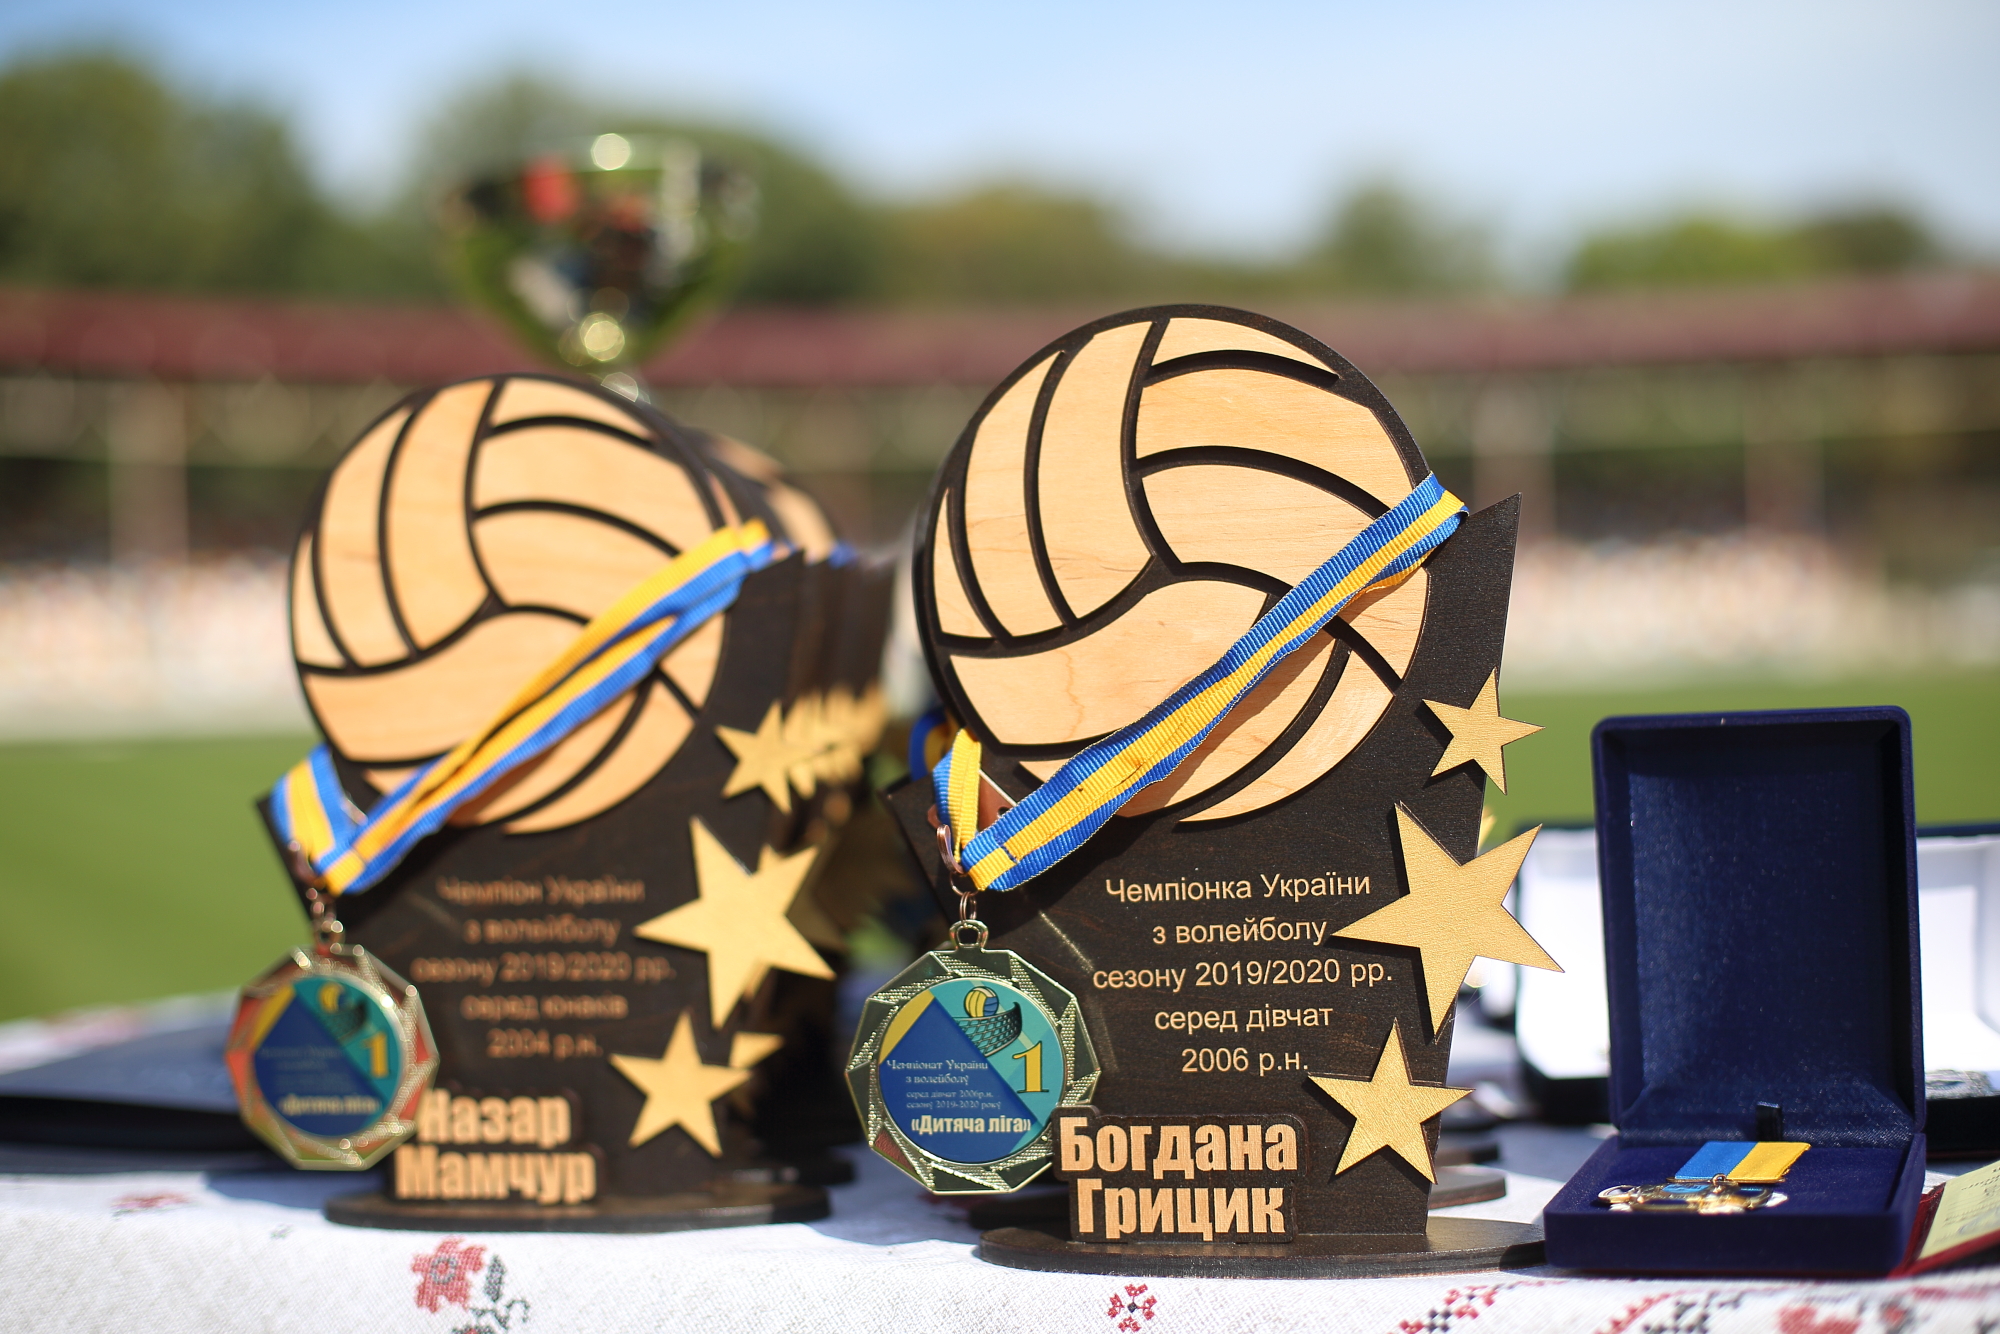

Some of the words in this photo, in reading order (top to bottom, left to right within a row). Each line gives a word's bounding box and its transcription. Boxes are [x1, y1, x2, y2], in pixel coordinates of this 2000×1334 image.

[544, 874, 645, 907] України
[1105, 877, 1252, 903] Чемпіонка
[1260, 873, 1371, 901] України
[483, 914, 621, 947] волейболу
[1152, 924, 1166, 944] з
[1176, 916, 1327, 945] волейболу
[1093, 966, 1187, 992] сезону
[1195, 959, 1341, 987] 2019/2020
[1351, 963, 1393, 987] рр.
[1154, 1011, 1239, 1034] серед
[1247, 1004, 1333, 1032] дівчат
[361, 1032, 389, 1078] 1
[887, 1060, 943, 1070] Чемпіонат
[947, 1059, 988, 1071] України
[1012, 1040, 1049, 1093] 1
[1181, 1048, 1249, 1072] 2006
[1258, 1050, 1308, 1075] р.н.
[905, 1075, 912, 1083] з
[914, 1072, 969, 1085] волейболу
[418, 1088, 571, 1148] Назар
[911, 1115, 985, 1135] «Дитяча
[988, 1115, 1031, 1133] ліга»
[1059, 1116, 1298, 1180] Богдана
[396, 1143, 596, 1204] Мамчур
[1076, 1178, 1286, 1241] Грицик
